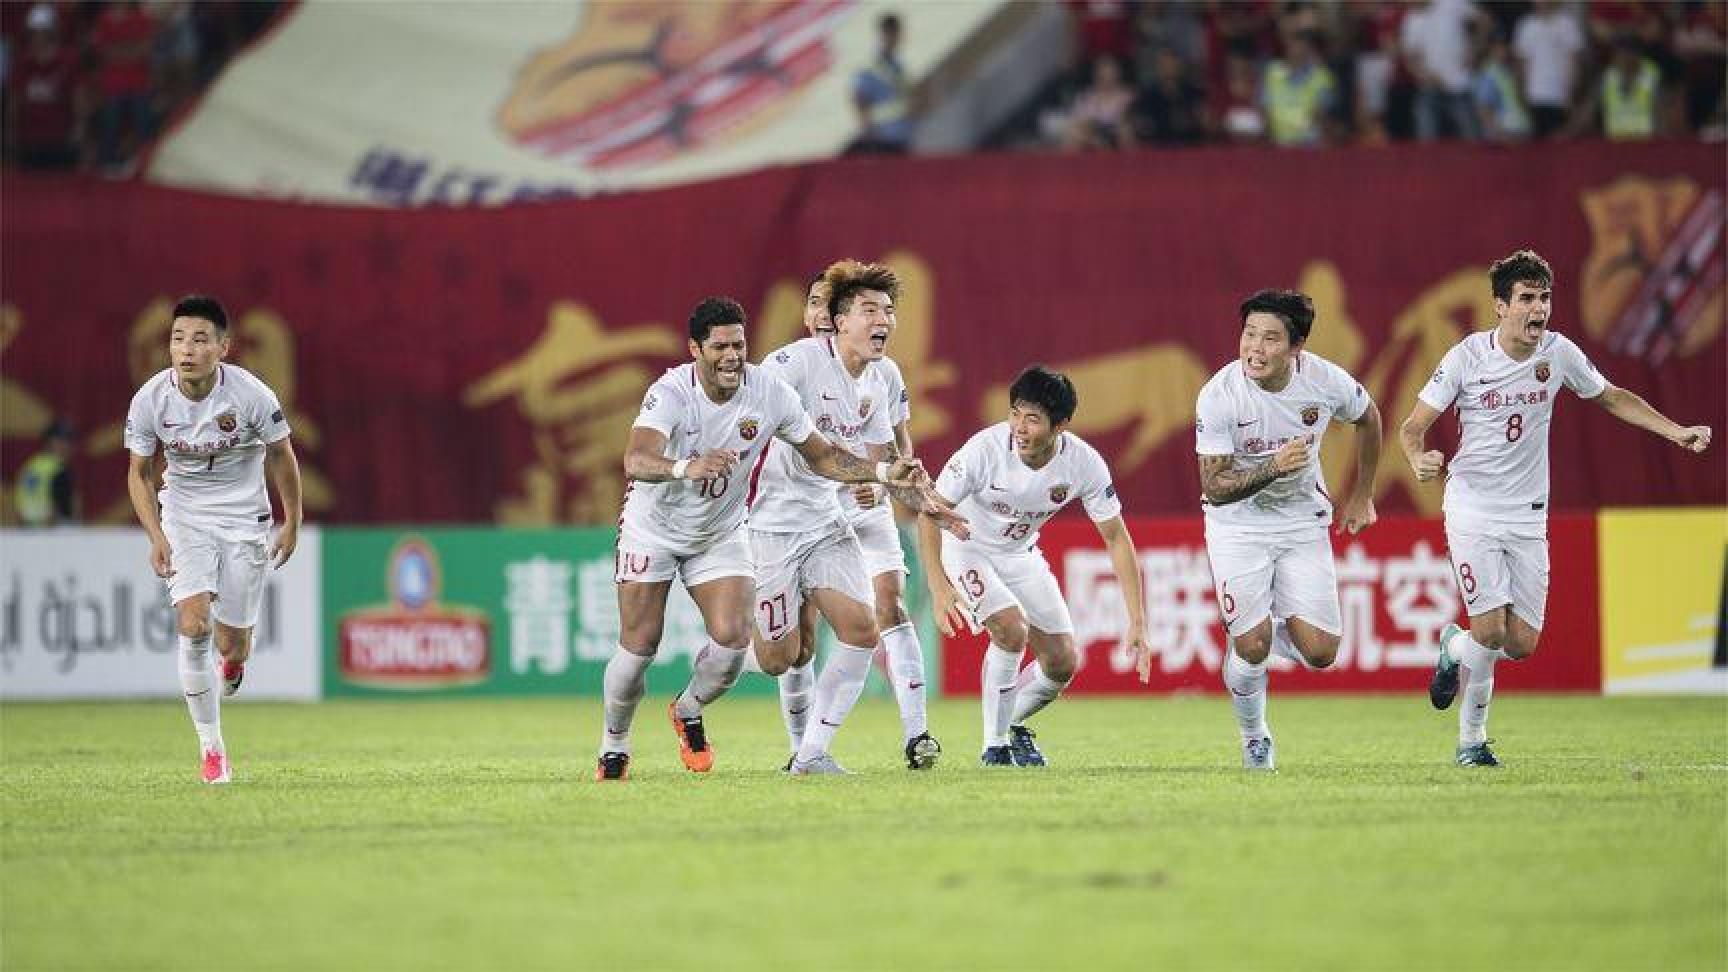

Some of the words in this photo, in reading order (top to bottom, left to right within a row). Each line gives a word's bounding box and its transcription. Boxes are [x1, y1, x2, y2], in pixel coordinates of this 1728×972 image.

[1506, 414, 1522, 442] 8
[701, 476, 728, 498] 10
[1003, 523, 1031, 540] 13
[958, 569, 985, 601] 13
[1460, 563, 1477, 594] 8
[760, 592, 789, 632] 27
[1223, 579, 1235, 614] 6
